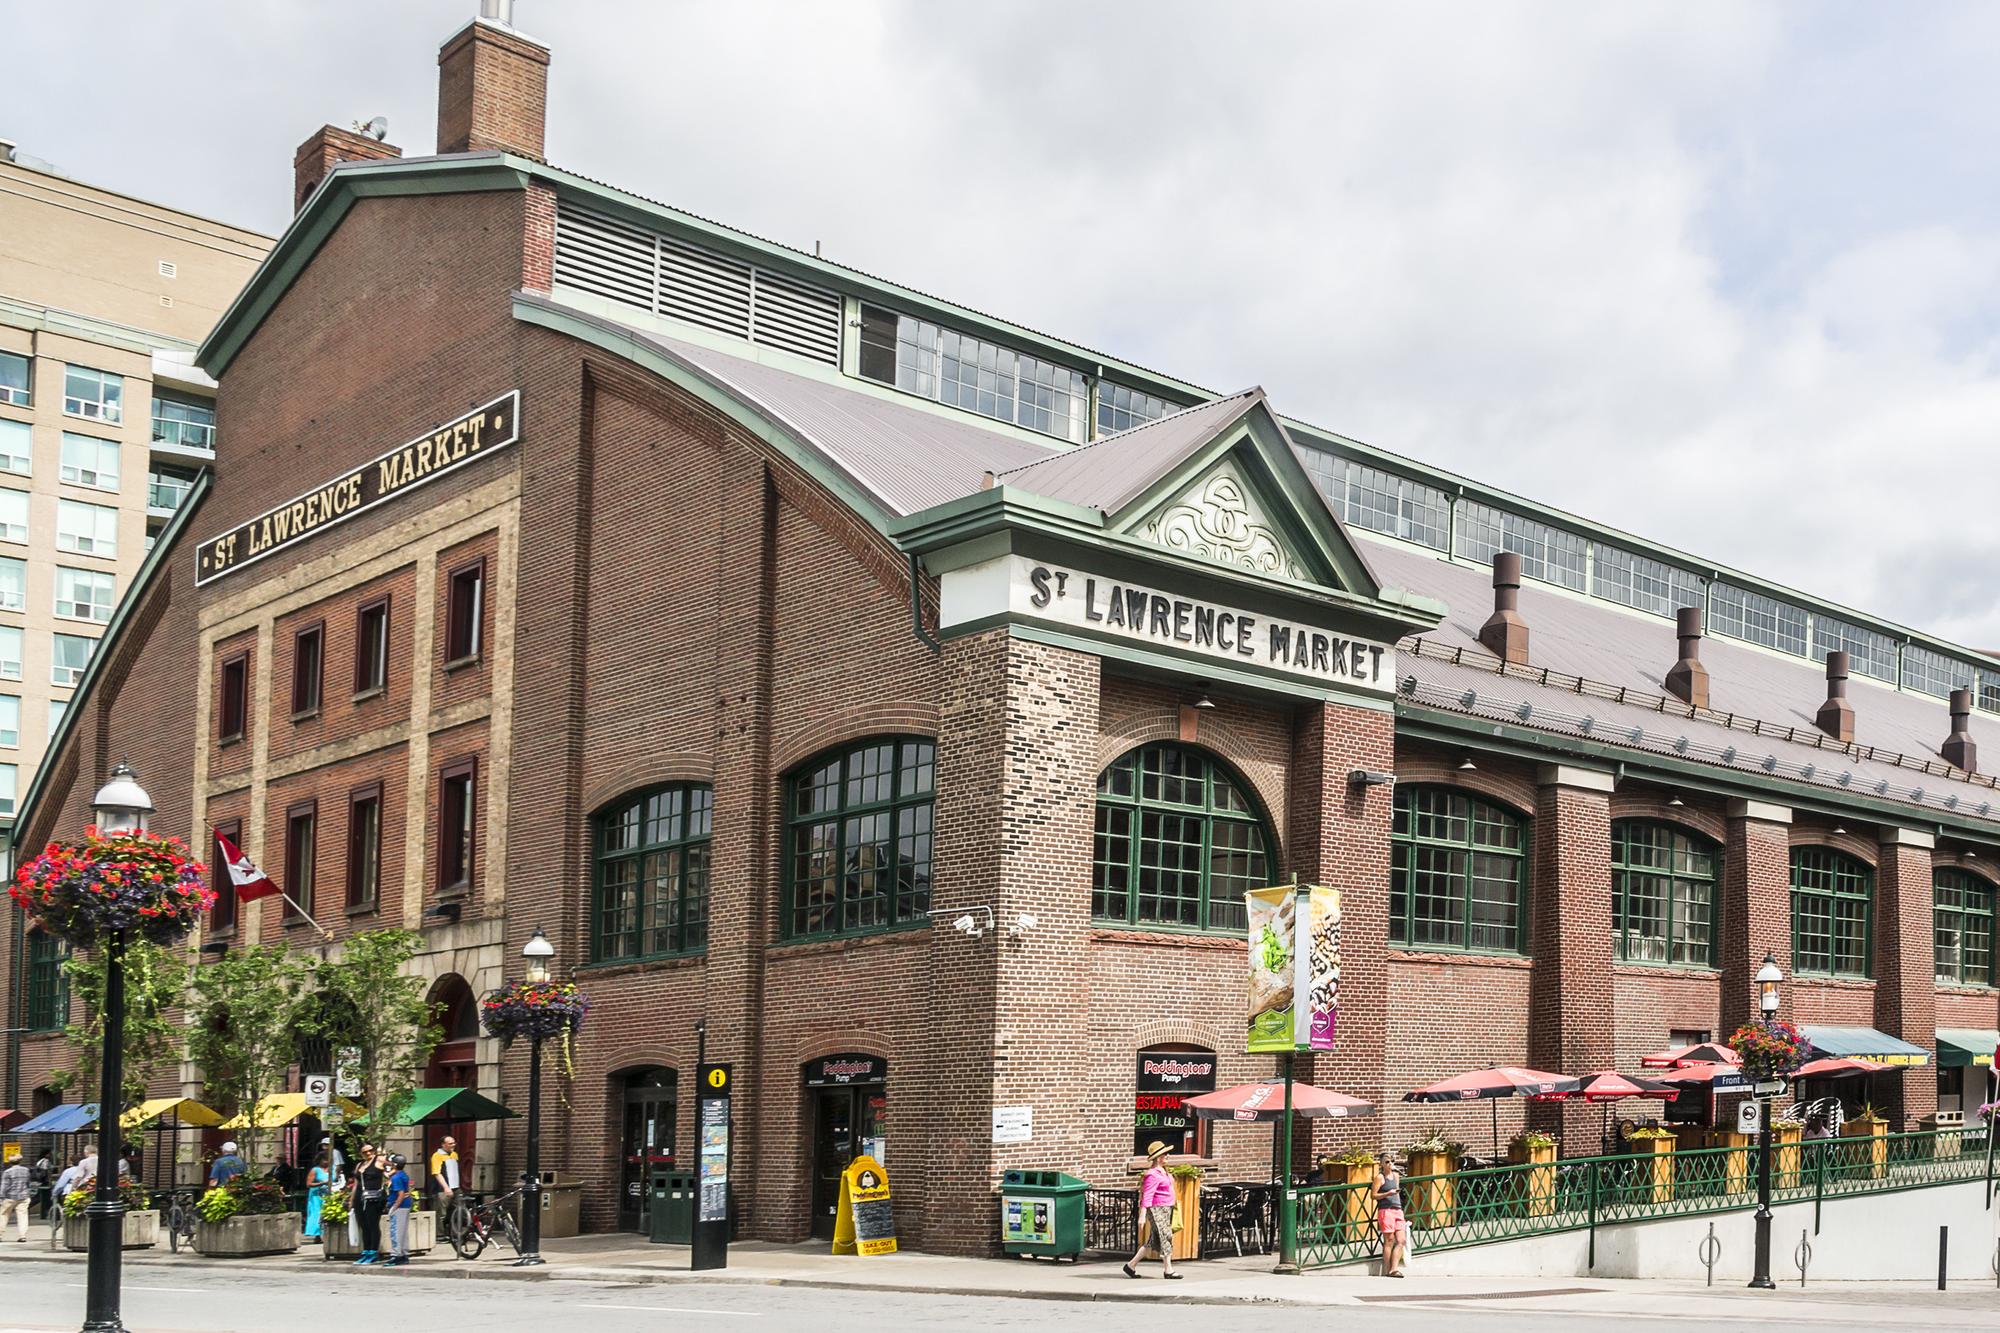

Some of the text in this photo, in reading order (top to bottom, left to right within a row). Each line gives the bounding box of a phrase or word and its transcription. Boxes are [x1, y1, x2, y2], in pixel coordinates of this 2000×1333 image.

[248, 473, 362, 556] LAWRENCE
[378, 413, 486, 494] MARKET
[1086, 578, 1256, 656] LAWRENCE
[1269, 623, 1385, 682] MARKET
[1144, 1060, 1212, 1078] Paddington's
[1161, 1073, 1182, 1083] Pump
[1722, 1076, 1740, 1085] Front
